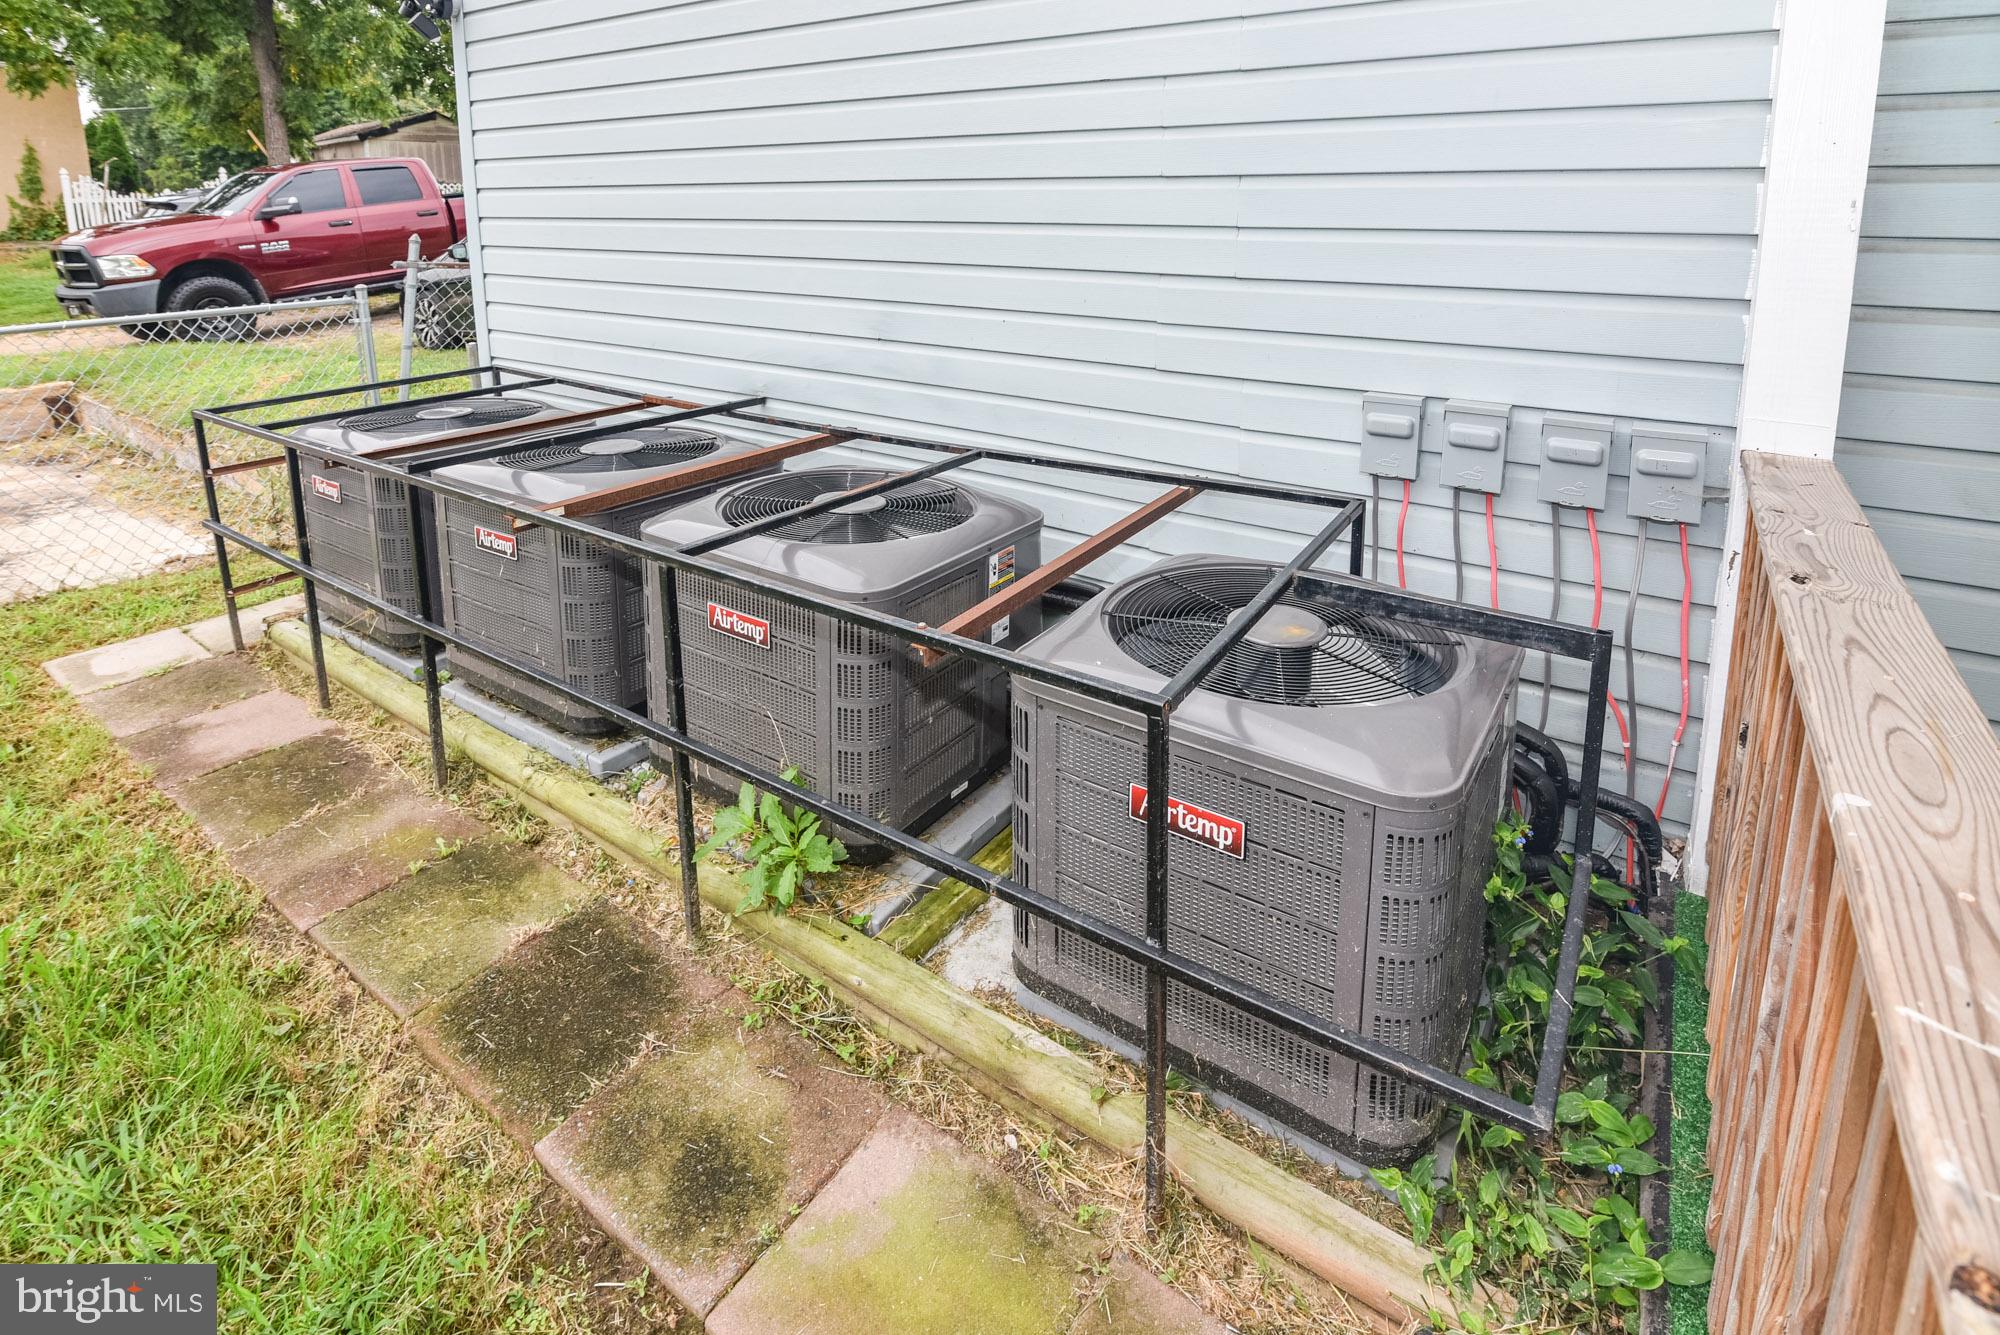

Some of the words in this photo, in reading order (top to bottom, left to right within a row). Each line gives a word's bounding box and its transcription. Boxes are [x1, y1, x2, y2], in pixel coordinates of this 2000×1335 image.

[479, 529, 513, 557] Airtemp
[713, 608, 764, 643] Airtemp
[1139, 792, 1233, 849] rtemp
